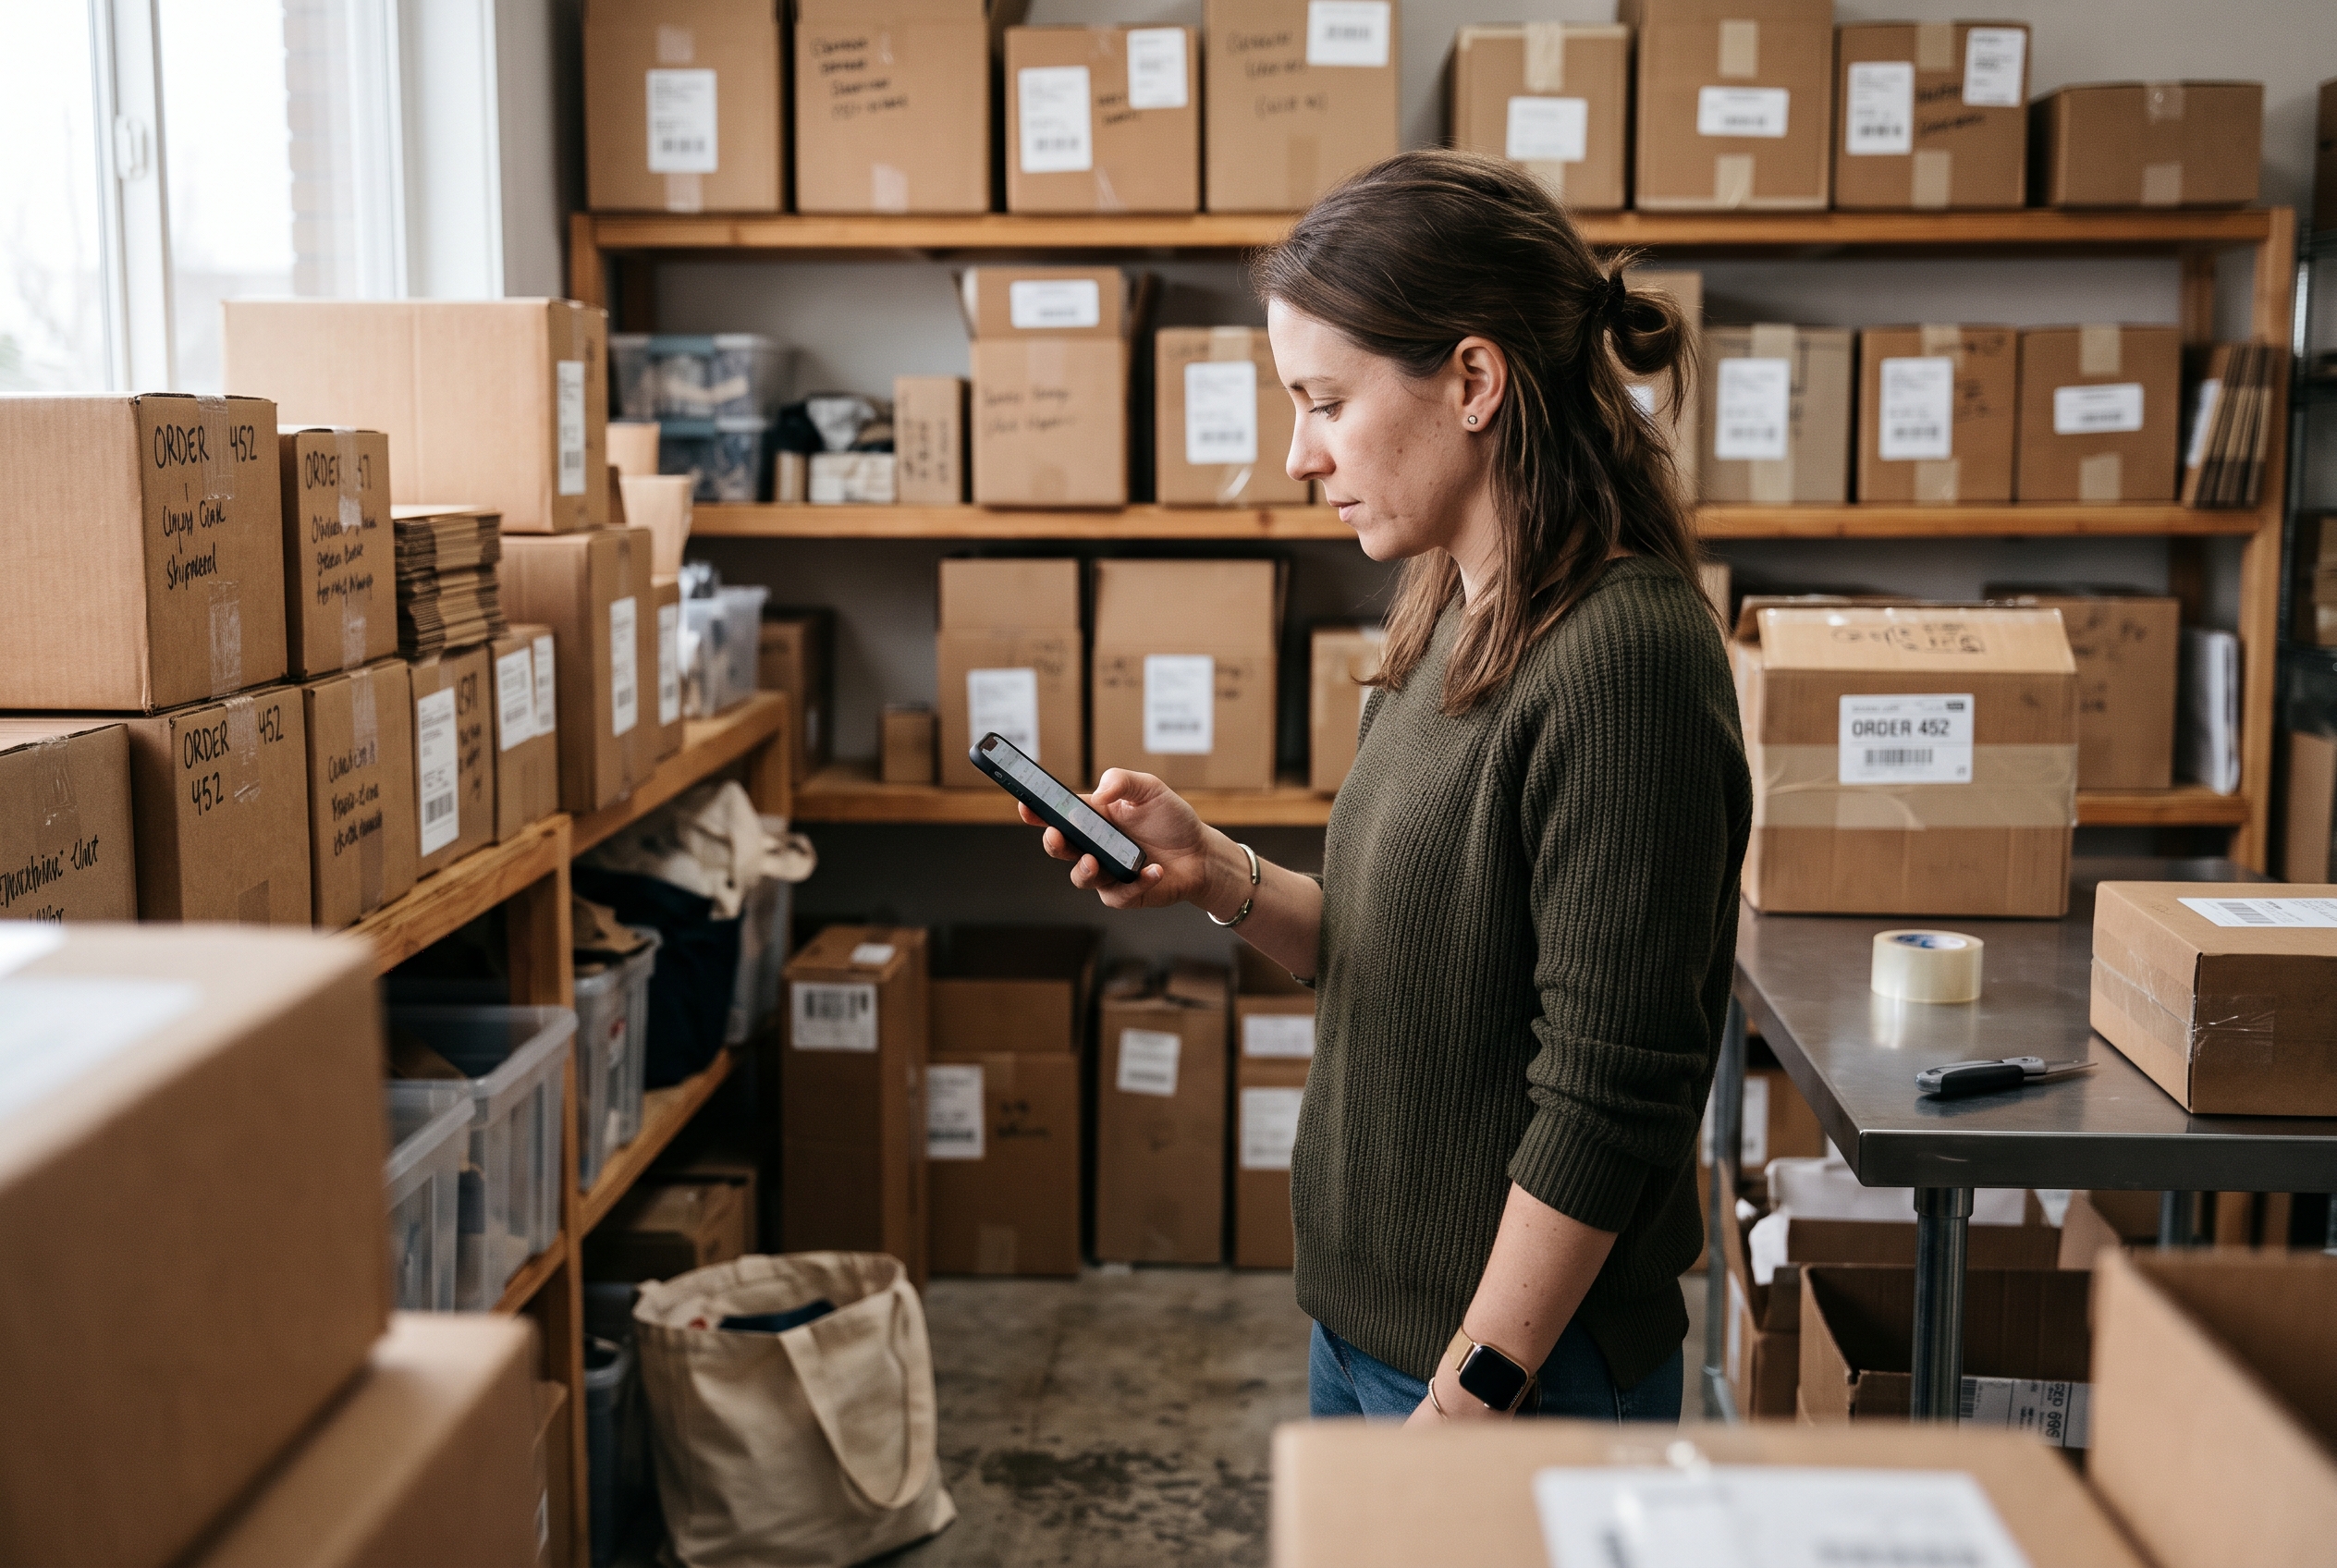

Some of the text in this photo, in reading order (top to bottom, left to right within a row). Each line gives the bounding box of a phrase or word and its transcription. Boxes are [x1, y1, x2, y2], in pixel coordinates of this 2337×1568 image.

[154, 423, 258, 469] ORDER 452
[184, 704, 284, 769] ORDER 452
[1852, 717, 1951, 738] ORDER 452
[191, 771, 225, 816] 452
